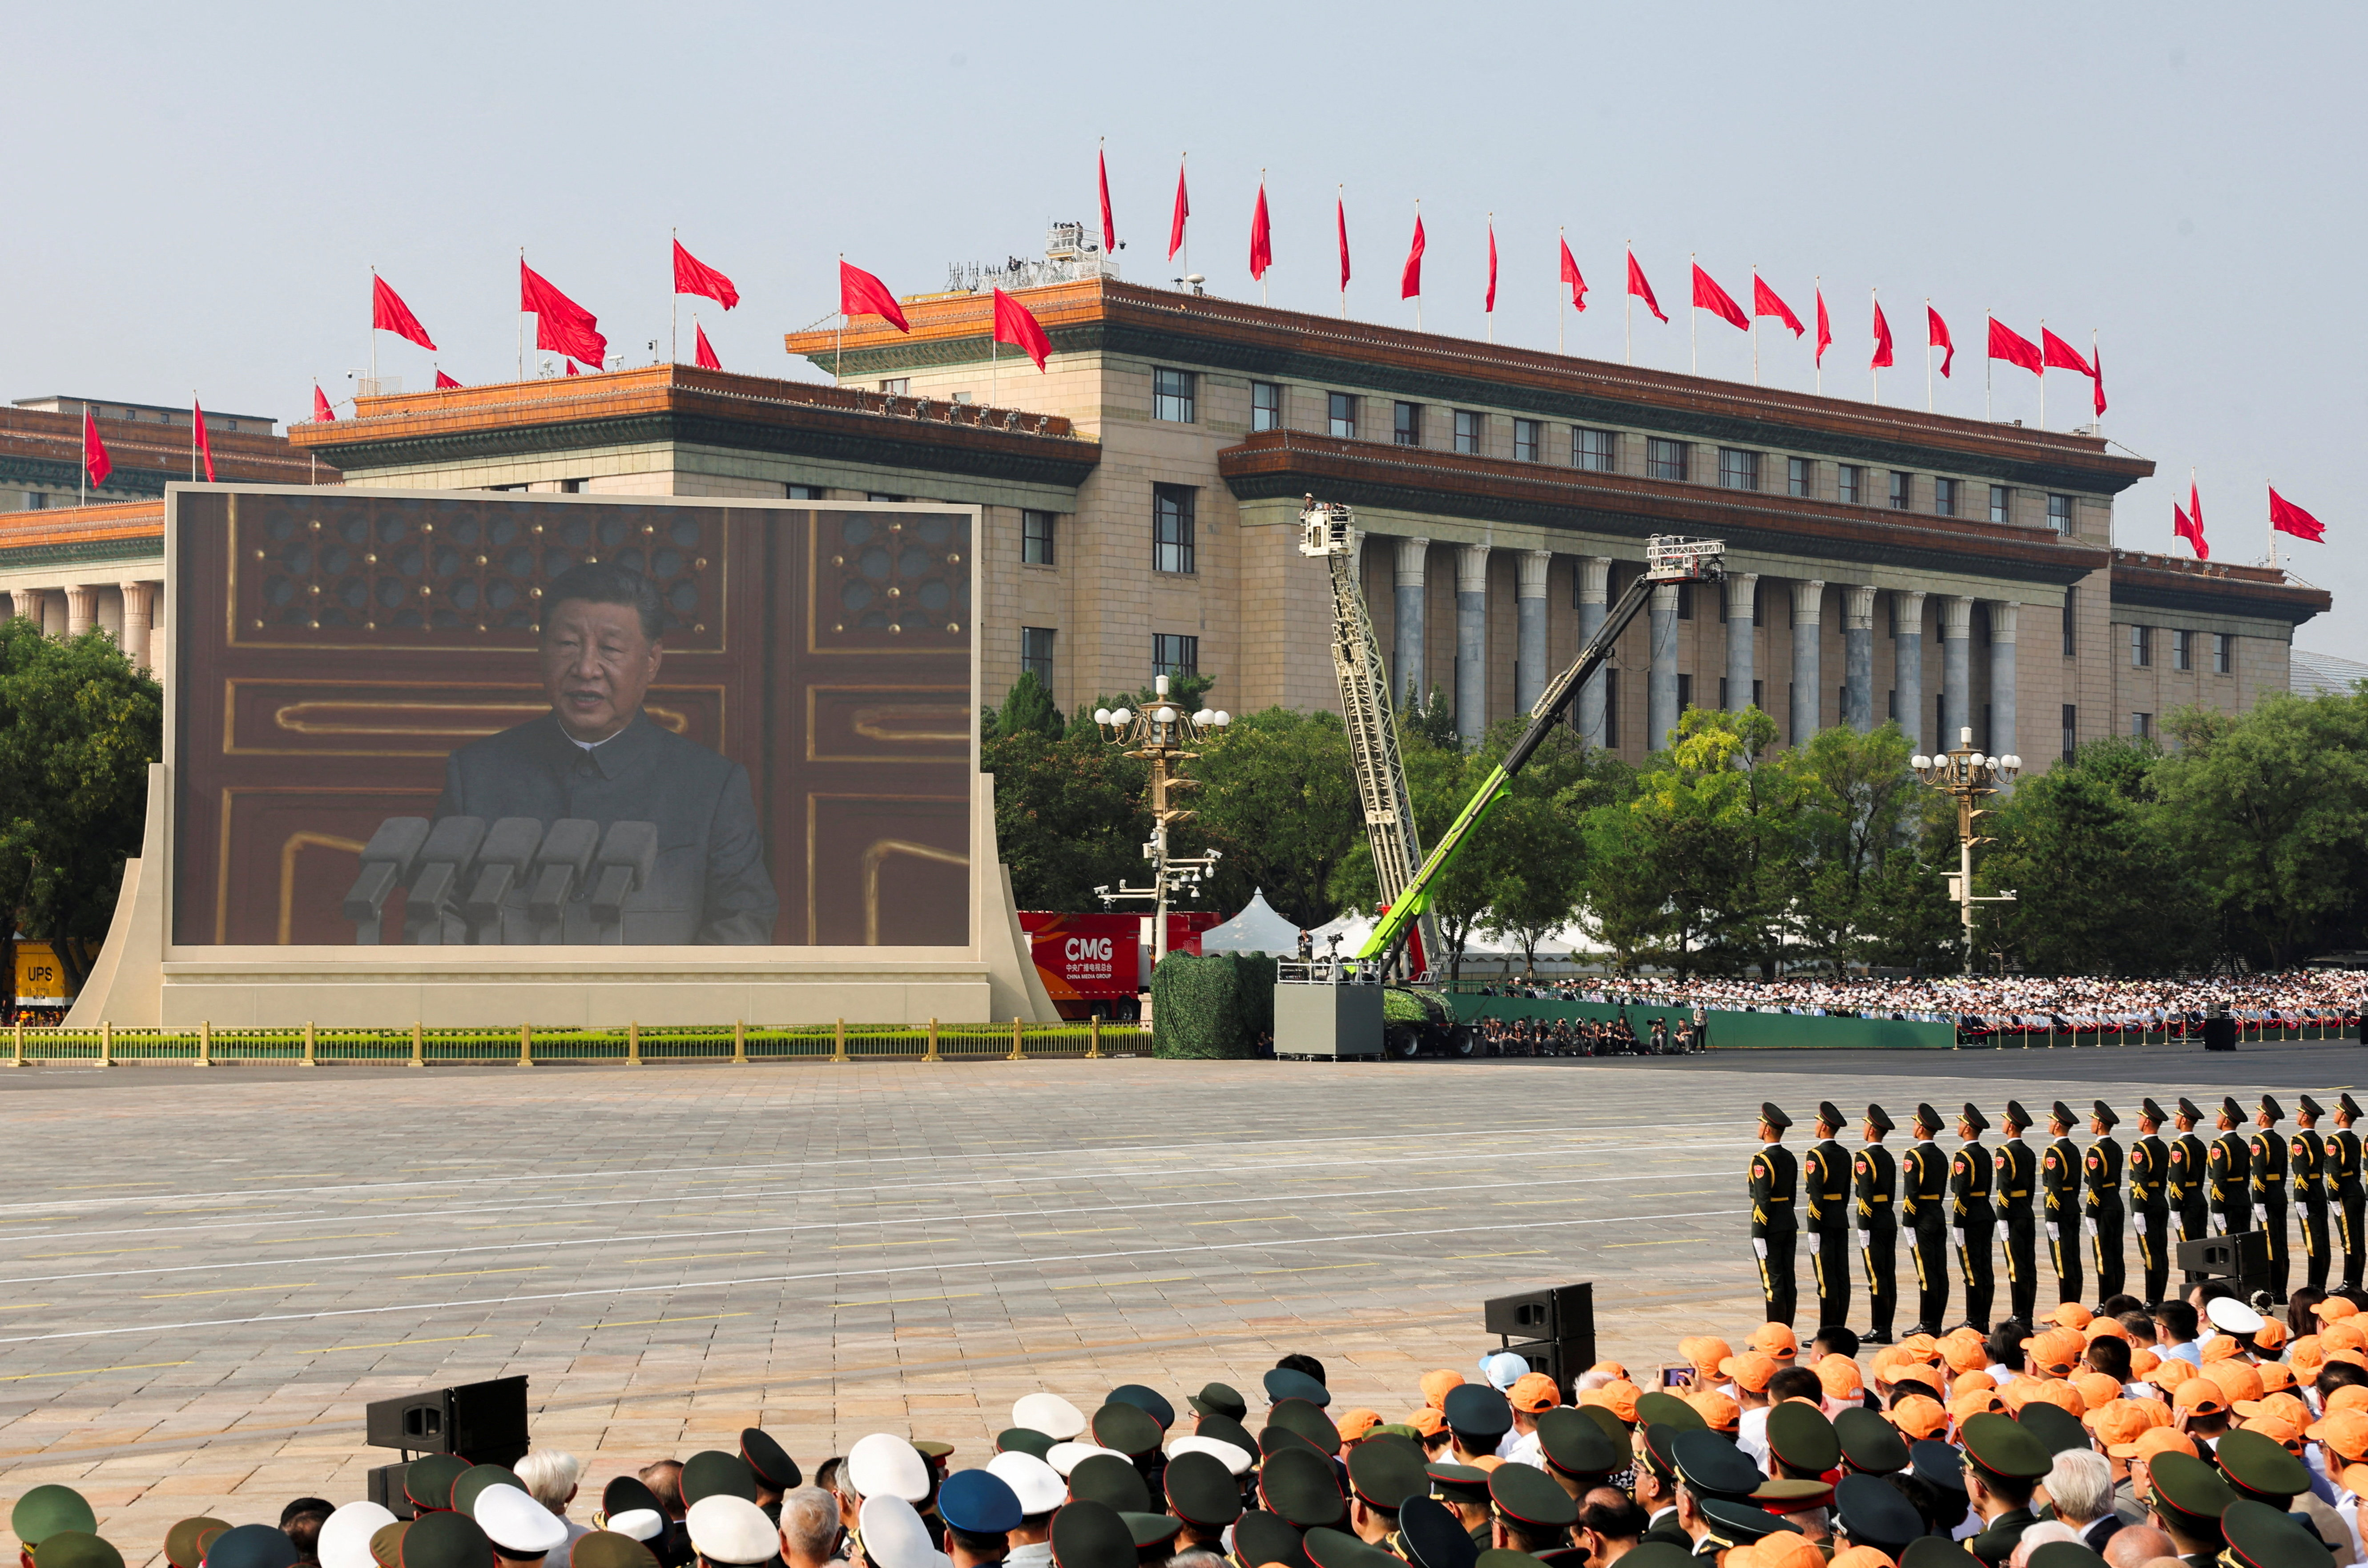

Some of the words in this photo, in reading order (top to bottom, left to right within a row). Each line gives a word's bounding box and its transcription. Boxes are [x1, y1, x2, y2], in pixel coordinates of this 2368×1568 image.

[1065, 937, 1112, 961] CMG
[28, 967, 52, 981] UPS
[1066, 963, 1112, 972] 中央广播电视总台
